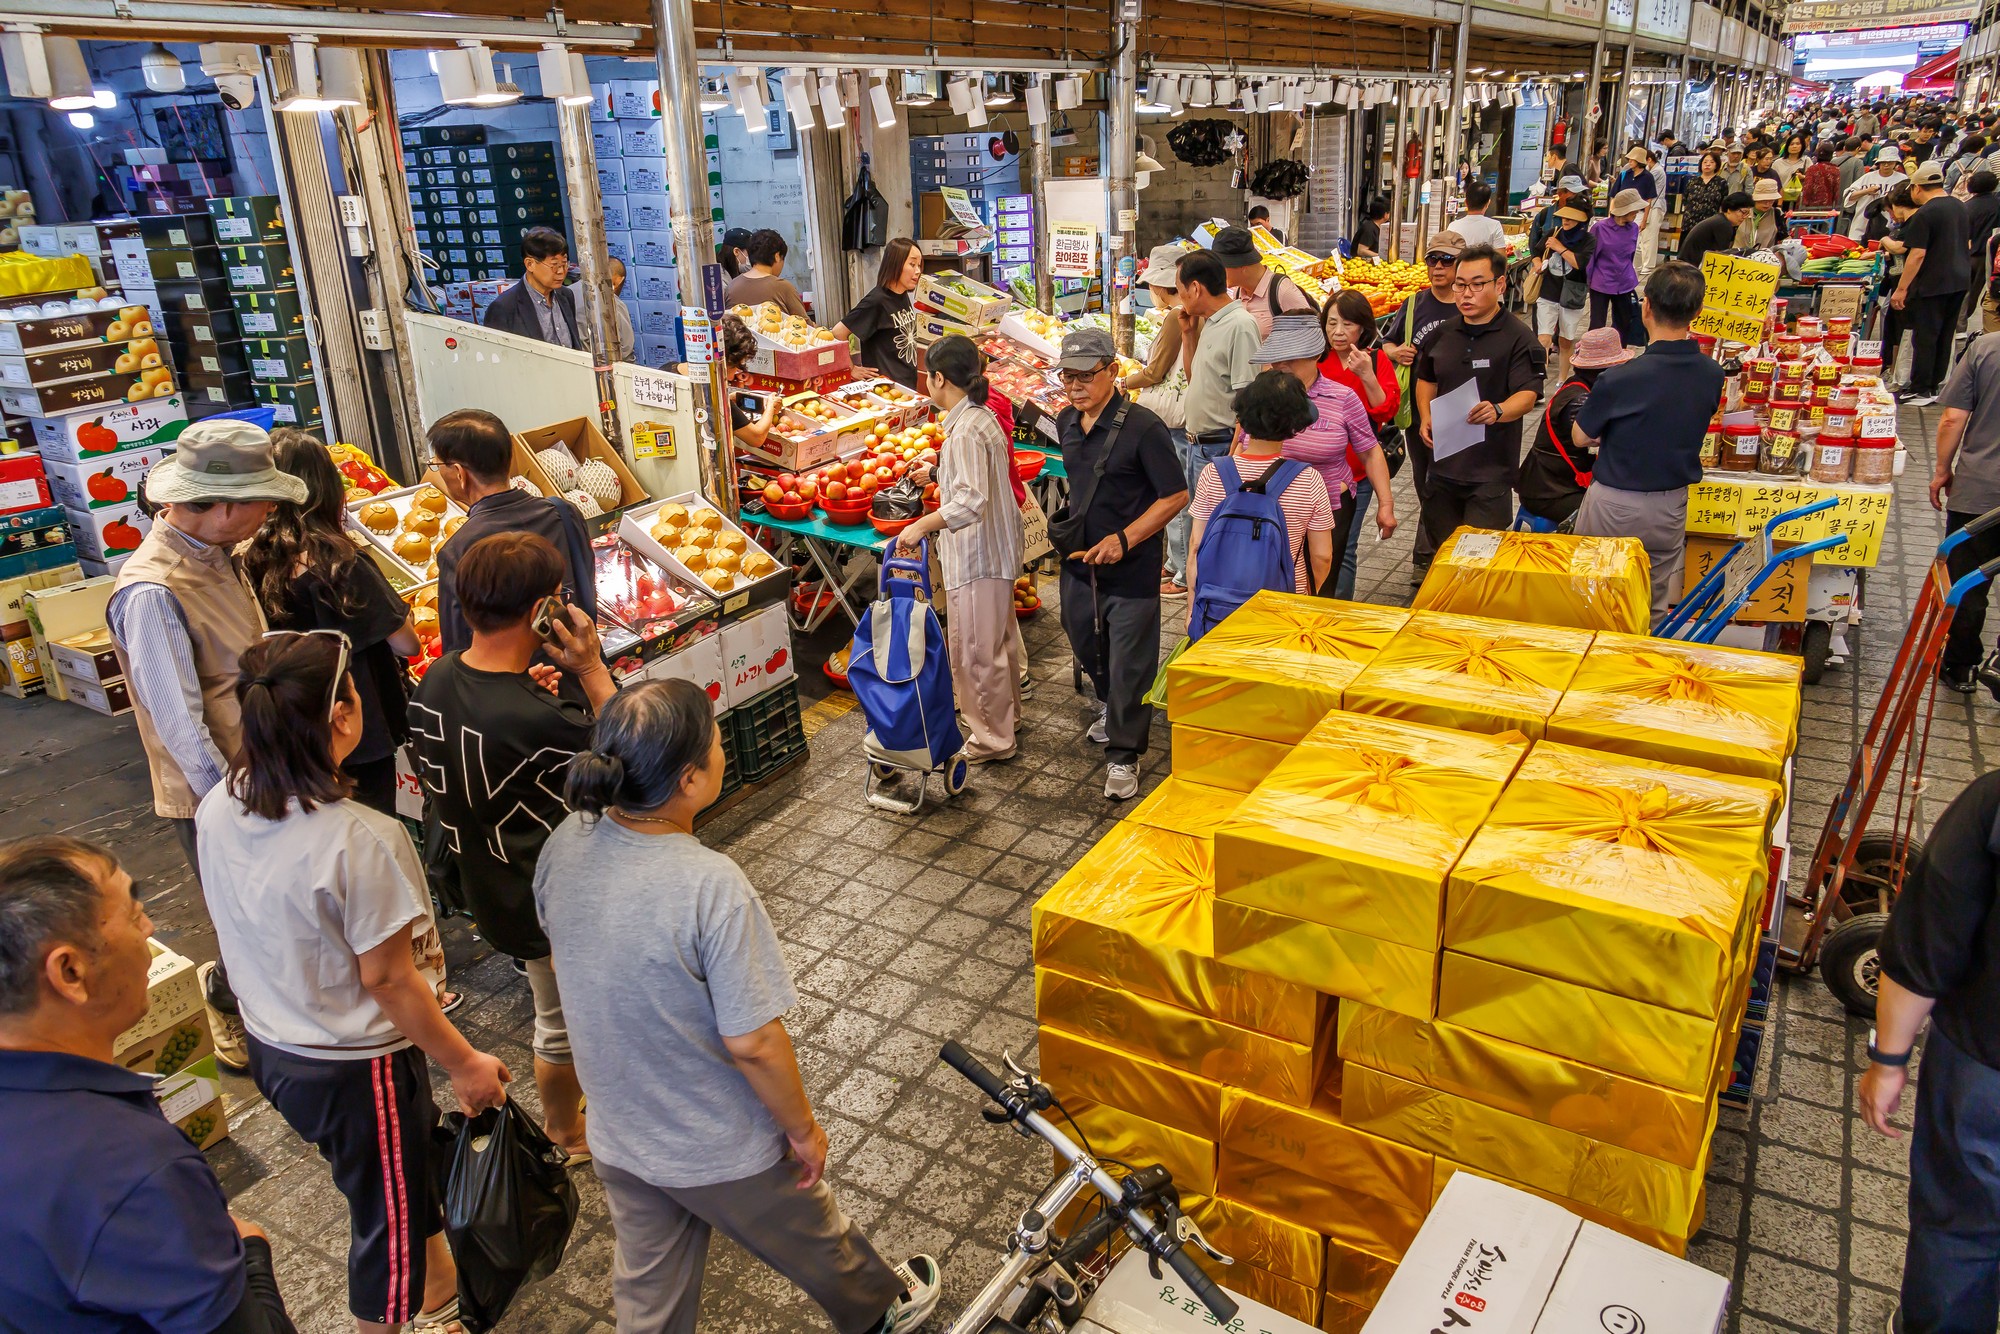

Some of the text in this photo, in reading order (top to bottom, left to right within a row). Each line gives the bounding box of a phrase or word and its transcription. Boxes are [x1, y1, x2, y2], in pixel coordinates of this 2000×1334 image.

[1056, 238, 1089, 251] 환급행사
[1055, 251, 1089, 264] 참여점포
[1704, 285, 1770, 315] 뚜기·토하젓
[131, 417, 161, 431] 사과
[1753, 488, 1819, 504] 오징어젓
[1694, 510, 1737, 527] 고들빼기
[1748, 523, 1804, 540] 배김치
[1828, 519, 1875, 537] 꼴뚜기
[656, 635, 676, 651] 사과
[735, 665, 763, 687] 사과
[1440, 1238, 1478, 1300] FRESH YEONGJU APPLE
[1457, 1293, 1486, 1311] 영주
